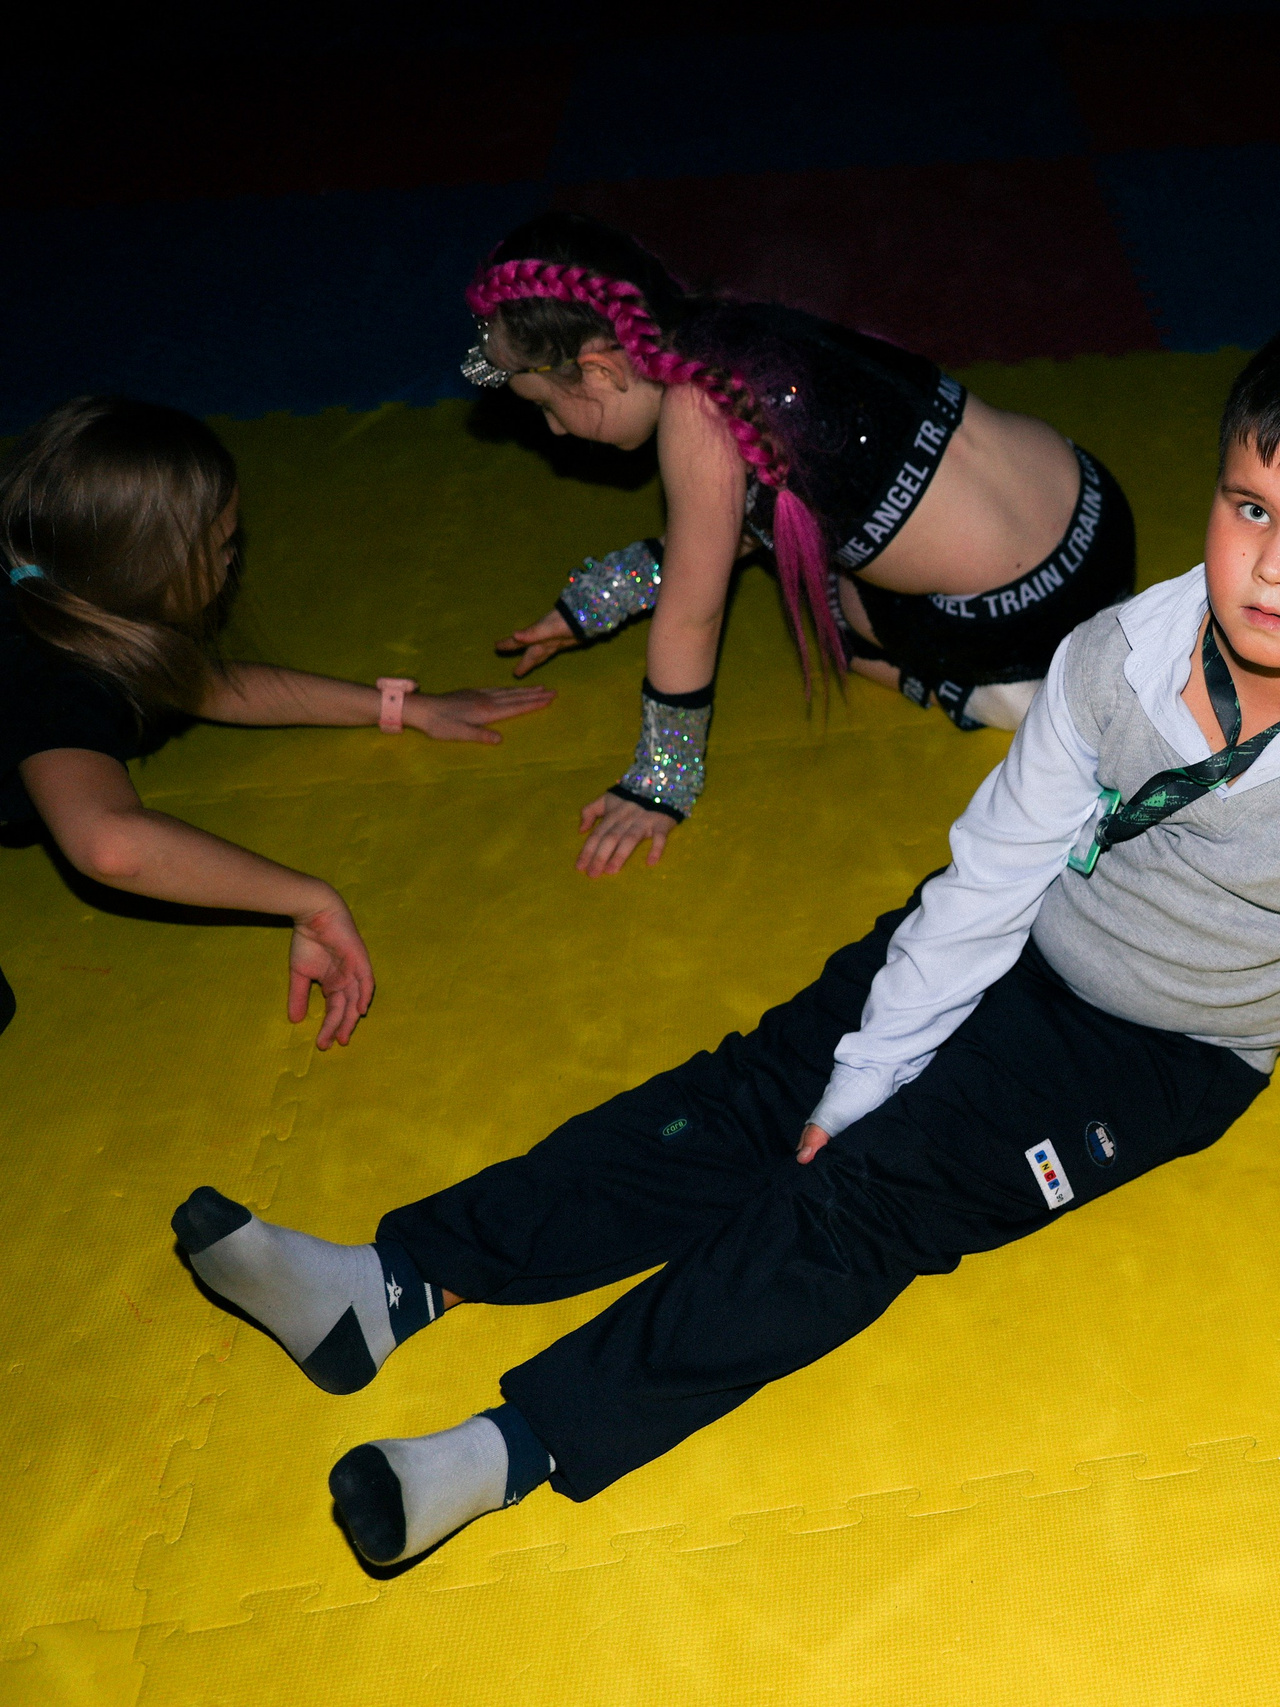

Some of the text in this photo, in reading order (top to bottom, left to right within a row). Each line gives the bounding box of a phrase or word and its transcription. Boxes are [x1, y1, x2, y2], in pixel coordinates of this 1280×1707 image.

[862, 461, 930, 545] ANGEL
[913, 419, 948, 457] TR
[981, 562, 1066, 619] TRAIN
